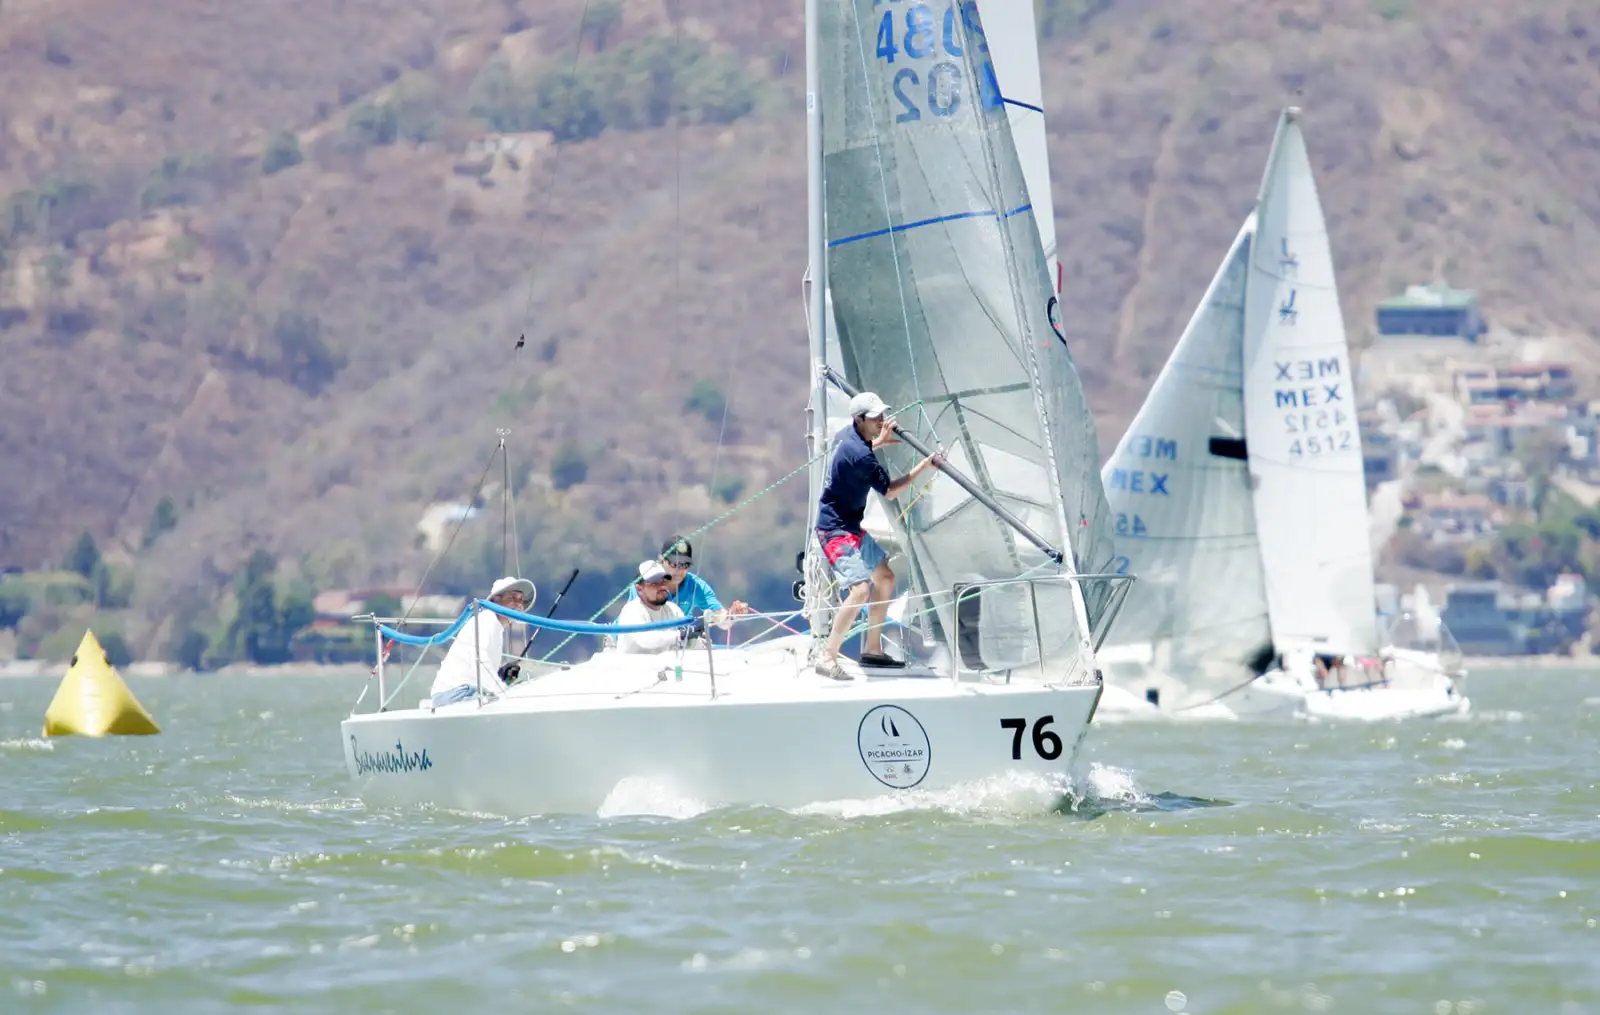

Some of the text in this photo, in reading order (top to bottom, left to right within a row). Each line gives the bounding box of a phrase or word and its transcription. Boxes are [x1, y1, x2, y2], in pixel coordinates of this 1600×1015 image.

[1275, 383, 1343, 408] MEX
[1289, 430, 1351, 455] 4512
[1111, 468, 1169, 495] MEX
[1000, 715, 1063, 760] 76
